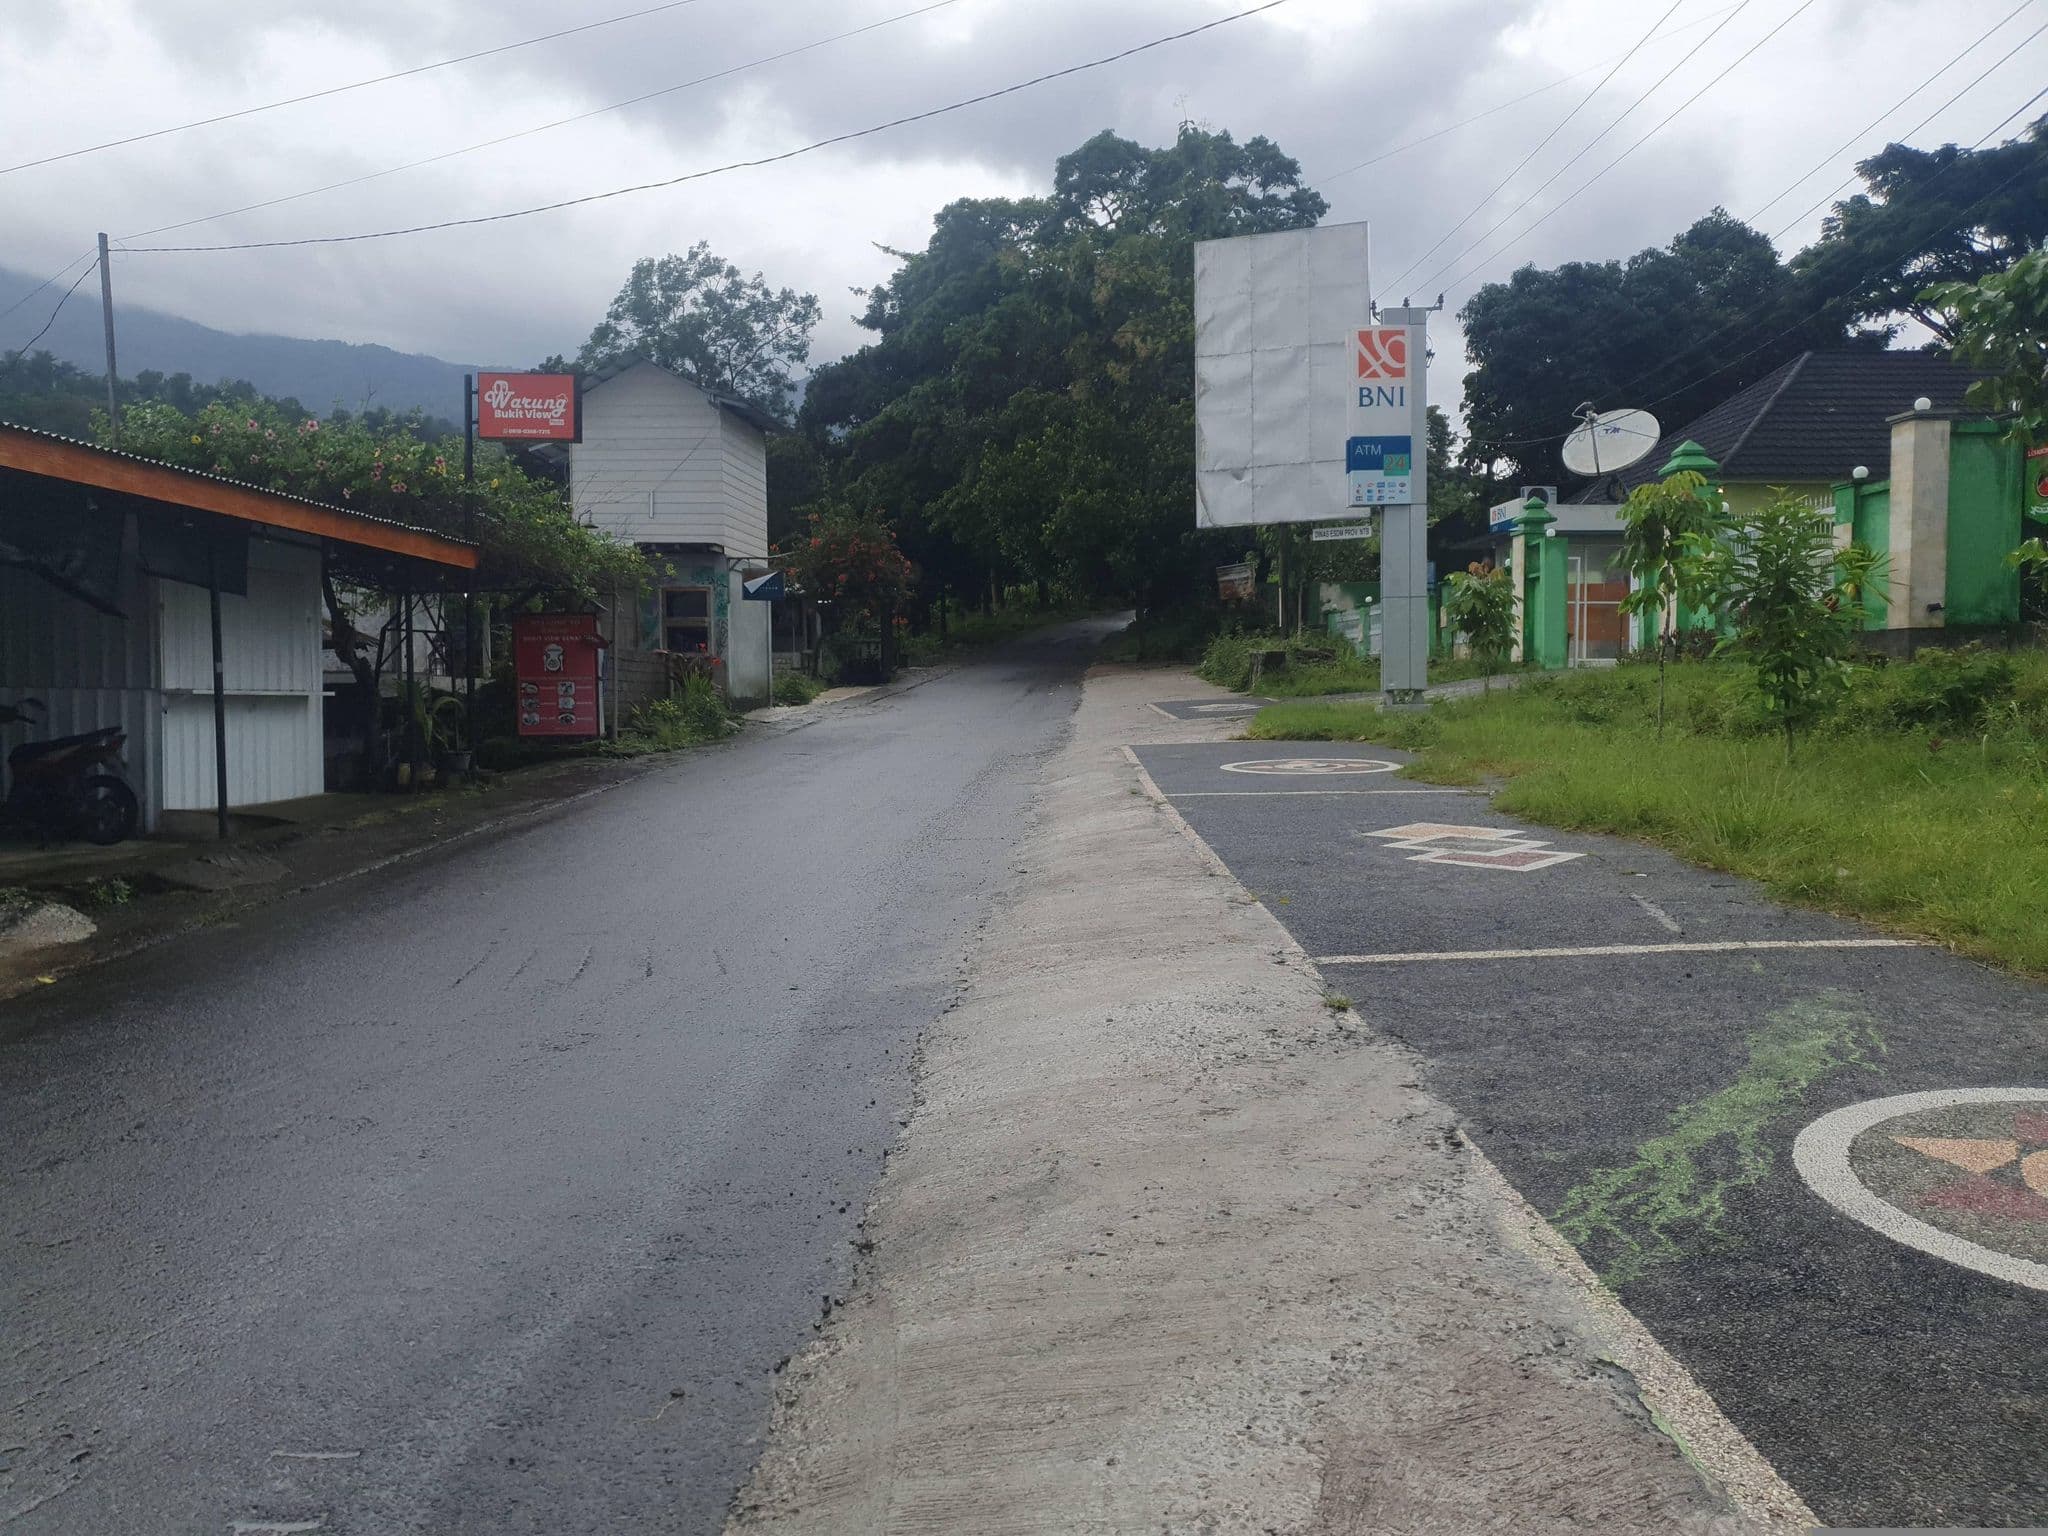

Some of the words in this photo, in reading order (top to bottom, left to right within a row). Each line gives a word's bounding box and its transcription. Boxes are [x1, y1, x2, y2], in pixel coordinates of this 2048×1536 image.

[484, 389, 568, 418] Warung
[1358, 386, 1405, 408] BNI
[495, 409, 523, 418] Bukit
[525, 409, 551, 418] View
[1354, 444, 1381, 456] ATM
[1384, 455, 1406, 471] 24
